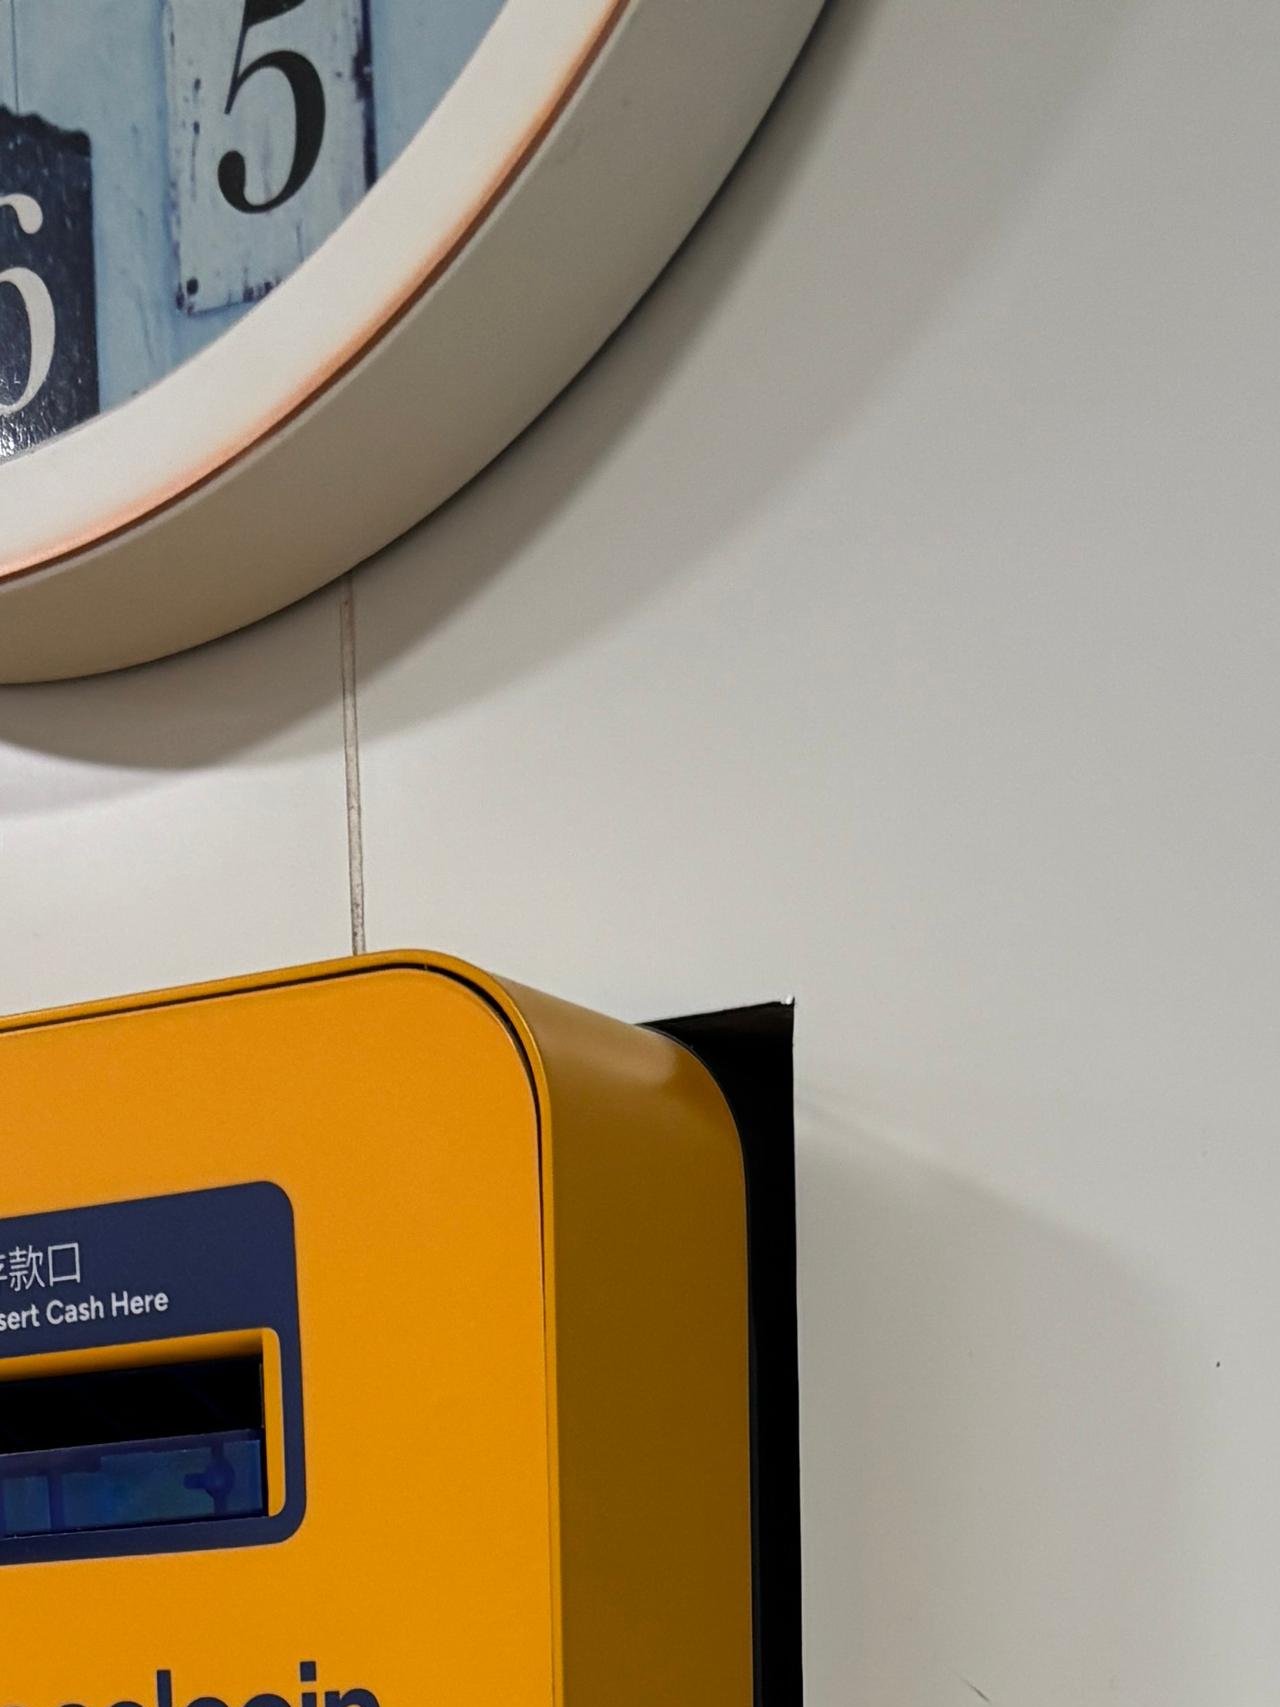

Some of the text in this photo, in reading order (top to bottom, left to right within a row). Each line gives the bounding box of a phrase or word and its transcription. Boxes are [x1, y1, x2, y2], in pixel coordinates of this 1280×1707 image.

[215, 0, 326, 214] 5
[46, 1295, 104, 1325] Cash
[111, 1290, 169, 1318] Here
